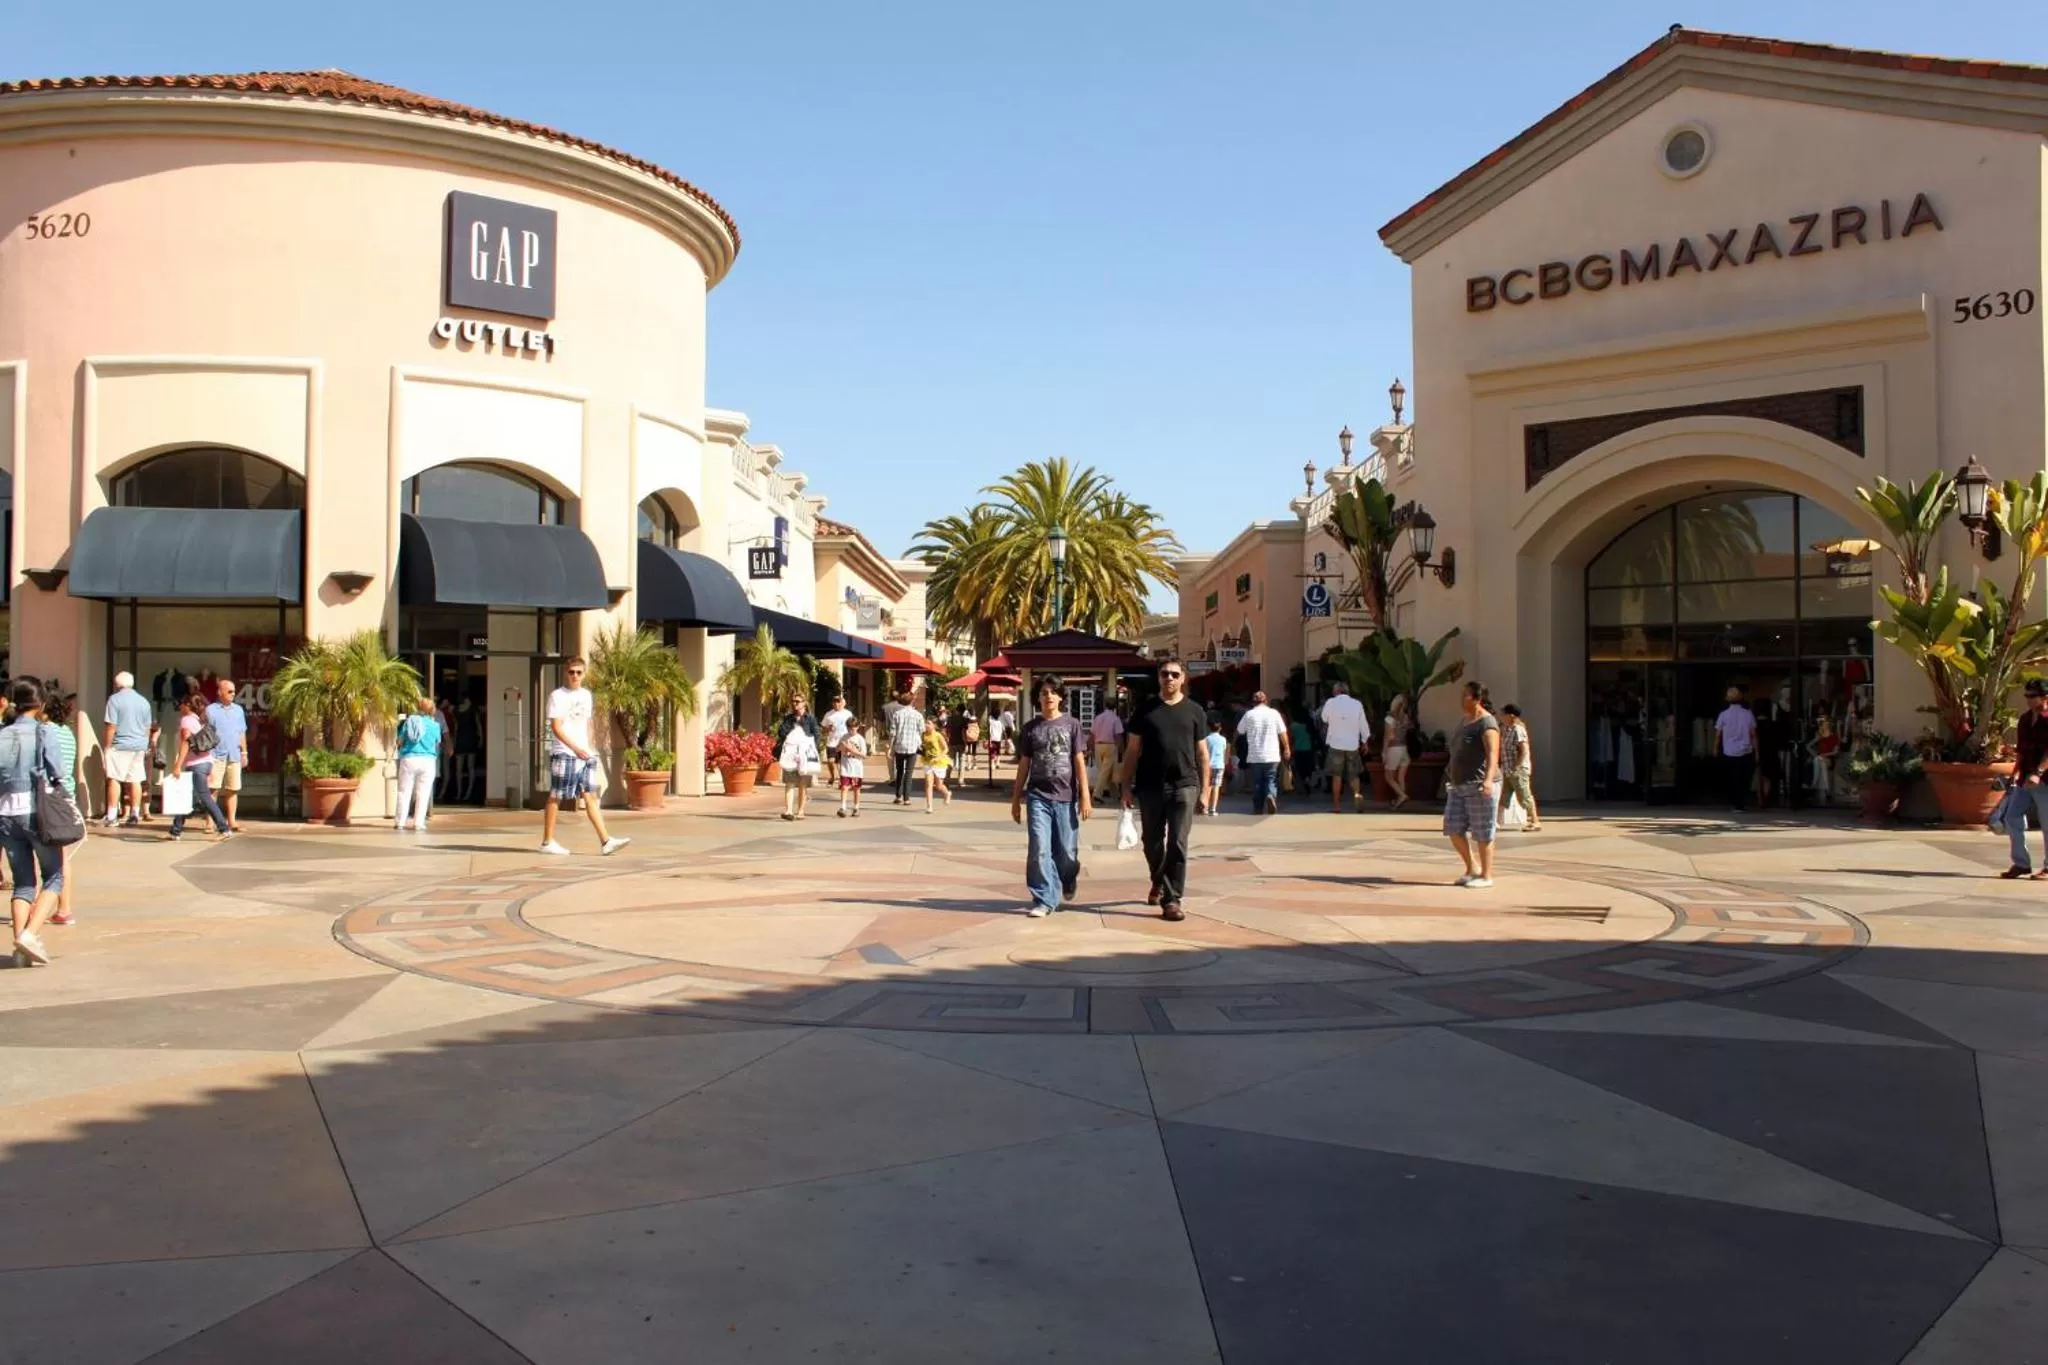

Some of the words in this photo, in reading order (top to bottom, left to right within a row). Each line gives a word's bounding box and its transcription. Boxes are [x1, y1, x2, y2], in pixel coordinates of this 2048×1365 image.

[25, 212, 91, 240] 5620
[471, 220, 540, 289] GAP
[1465, 192, 1944, 313] BCBGMAXAZRIA
[1953, 288, 2036, 324] 5630
[436, 316, 559, 355] OUTLET
[753, 552, 775, 570] GAP
